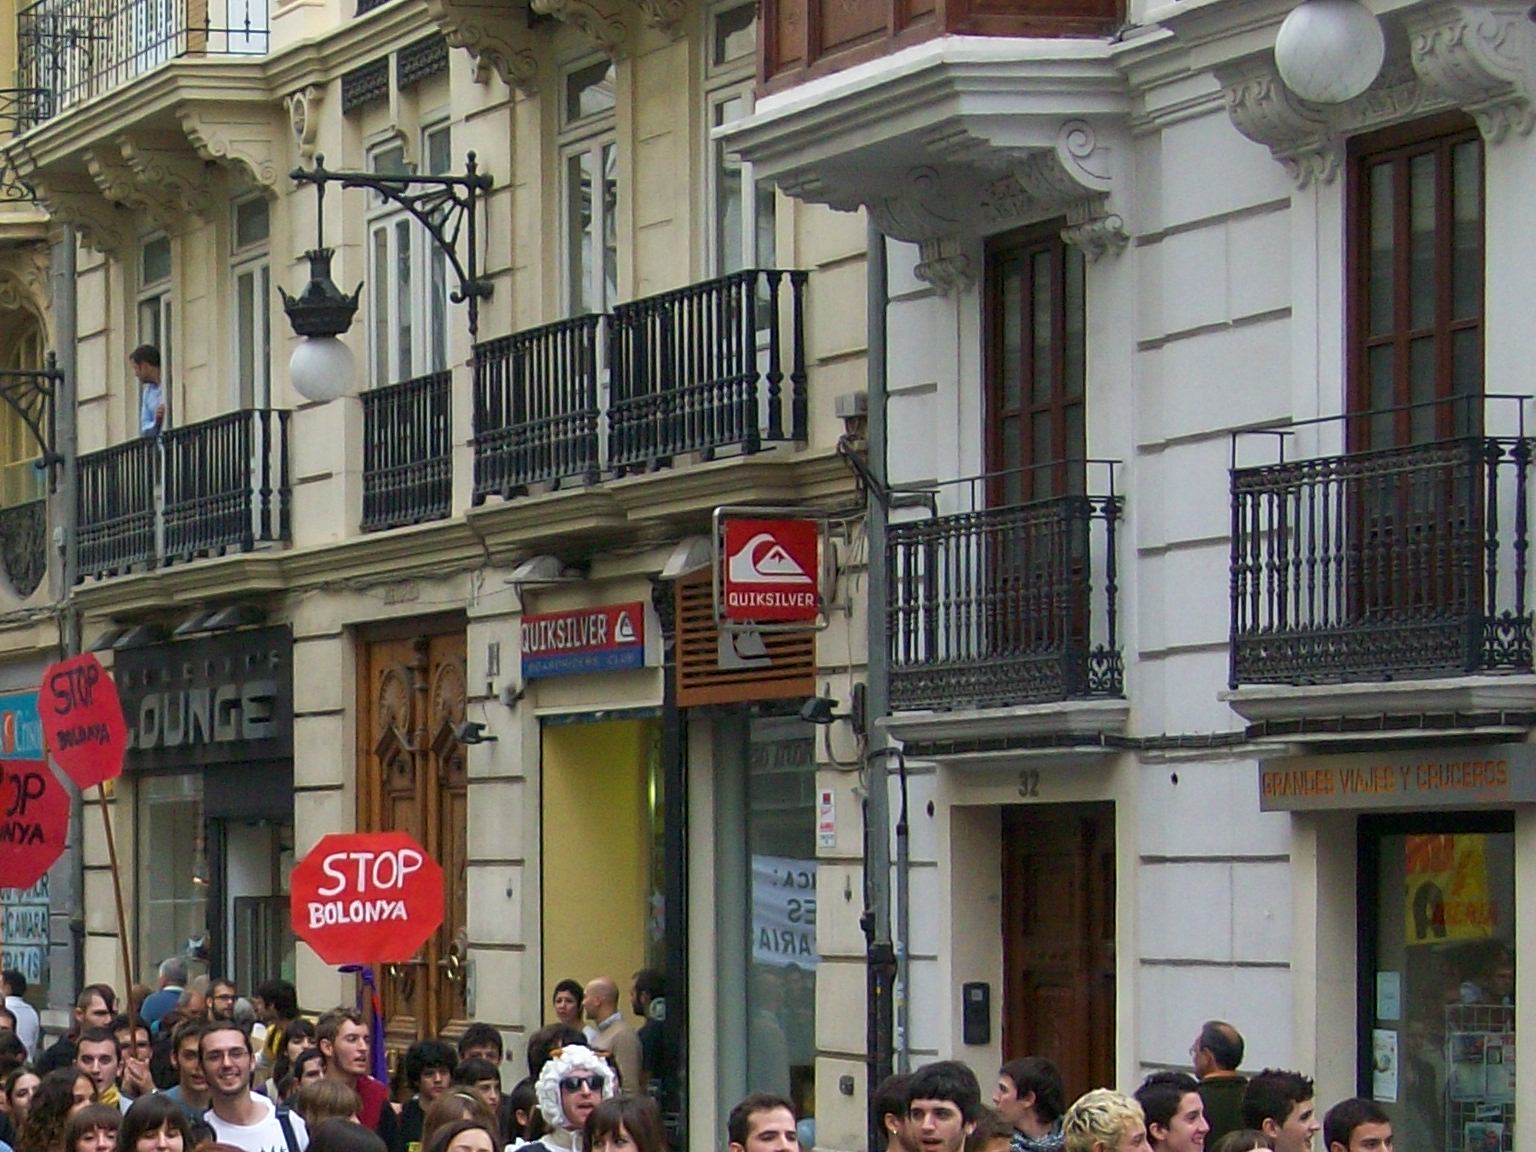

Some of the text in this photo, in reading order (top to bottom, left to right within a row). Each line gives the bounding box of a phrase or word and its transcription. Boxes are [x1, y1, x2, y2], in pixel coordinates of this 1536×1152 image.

[728, 592, 814, 607] QUIKSILVER
[520, 613, 608, 653] QUIKSILVER
[50, 664, 99, 716] STOP
[1018, 768, 1040, 798] 32
[1262, 760, 1508, 797] GRANDES VIAJES Y CRUCEROS
[317, 848, 423, 897] STOP
[307, 899, 408, 929] BOLONYA
